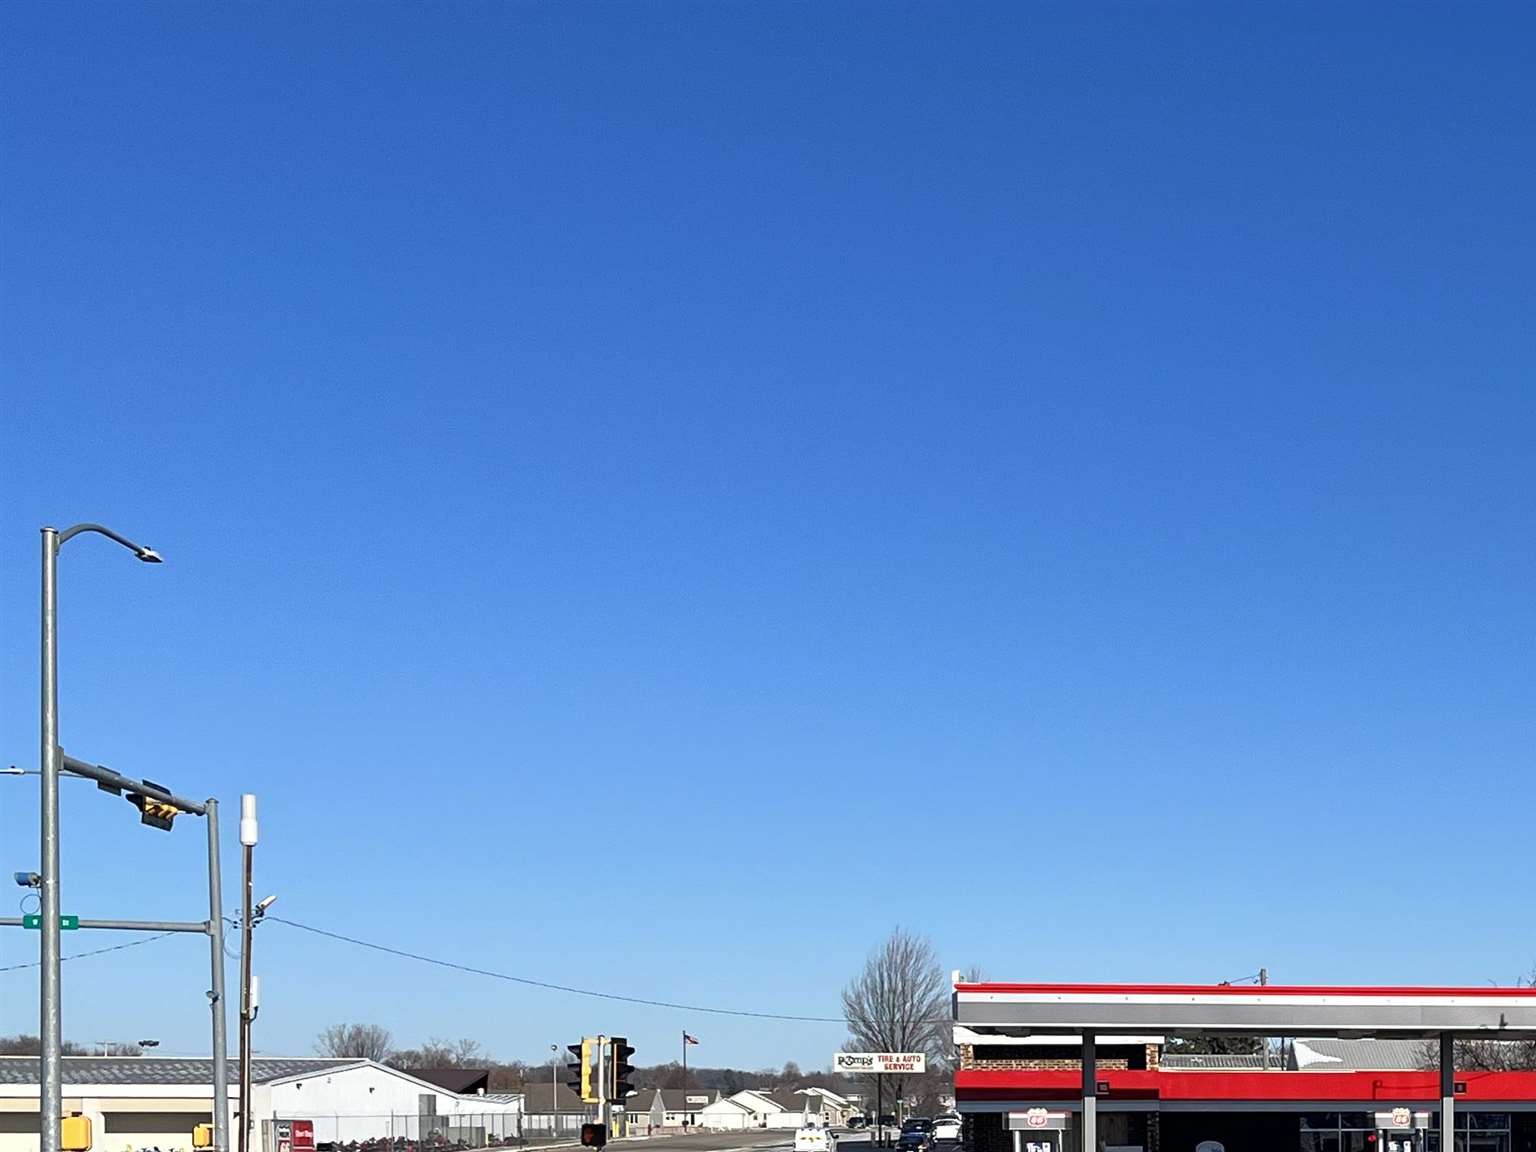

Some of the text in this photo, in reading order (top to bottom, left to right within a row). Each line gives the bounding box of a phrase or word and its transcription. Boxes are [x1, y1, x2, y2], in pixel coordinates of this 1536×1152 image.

[877, 1055, 894, 1063] TIRE
[902, 1055, 922, 1063] AUTO
[884, 1063, 915, 1071] SERVICE
